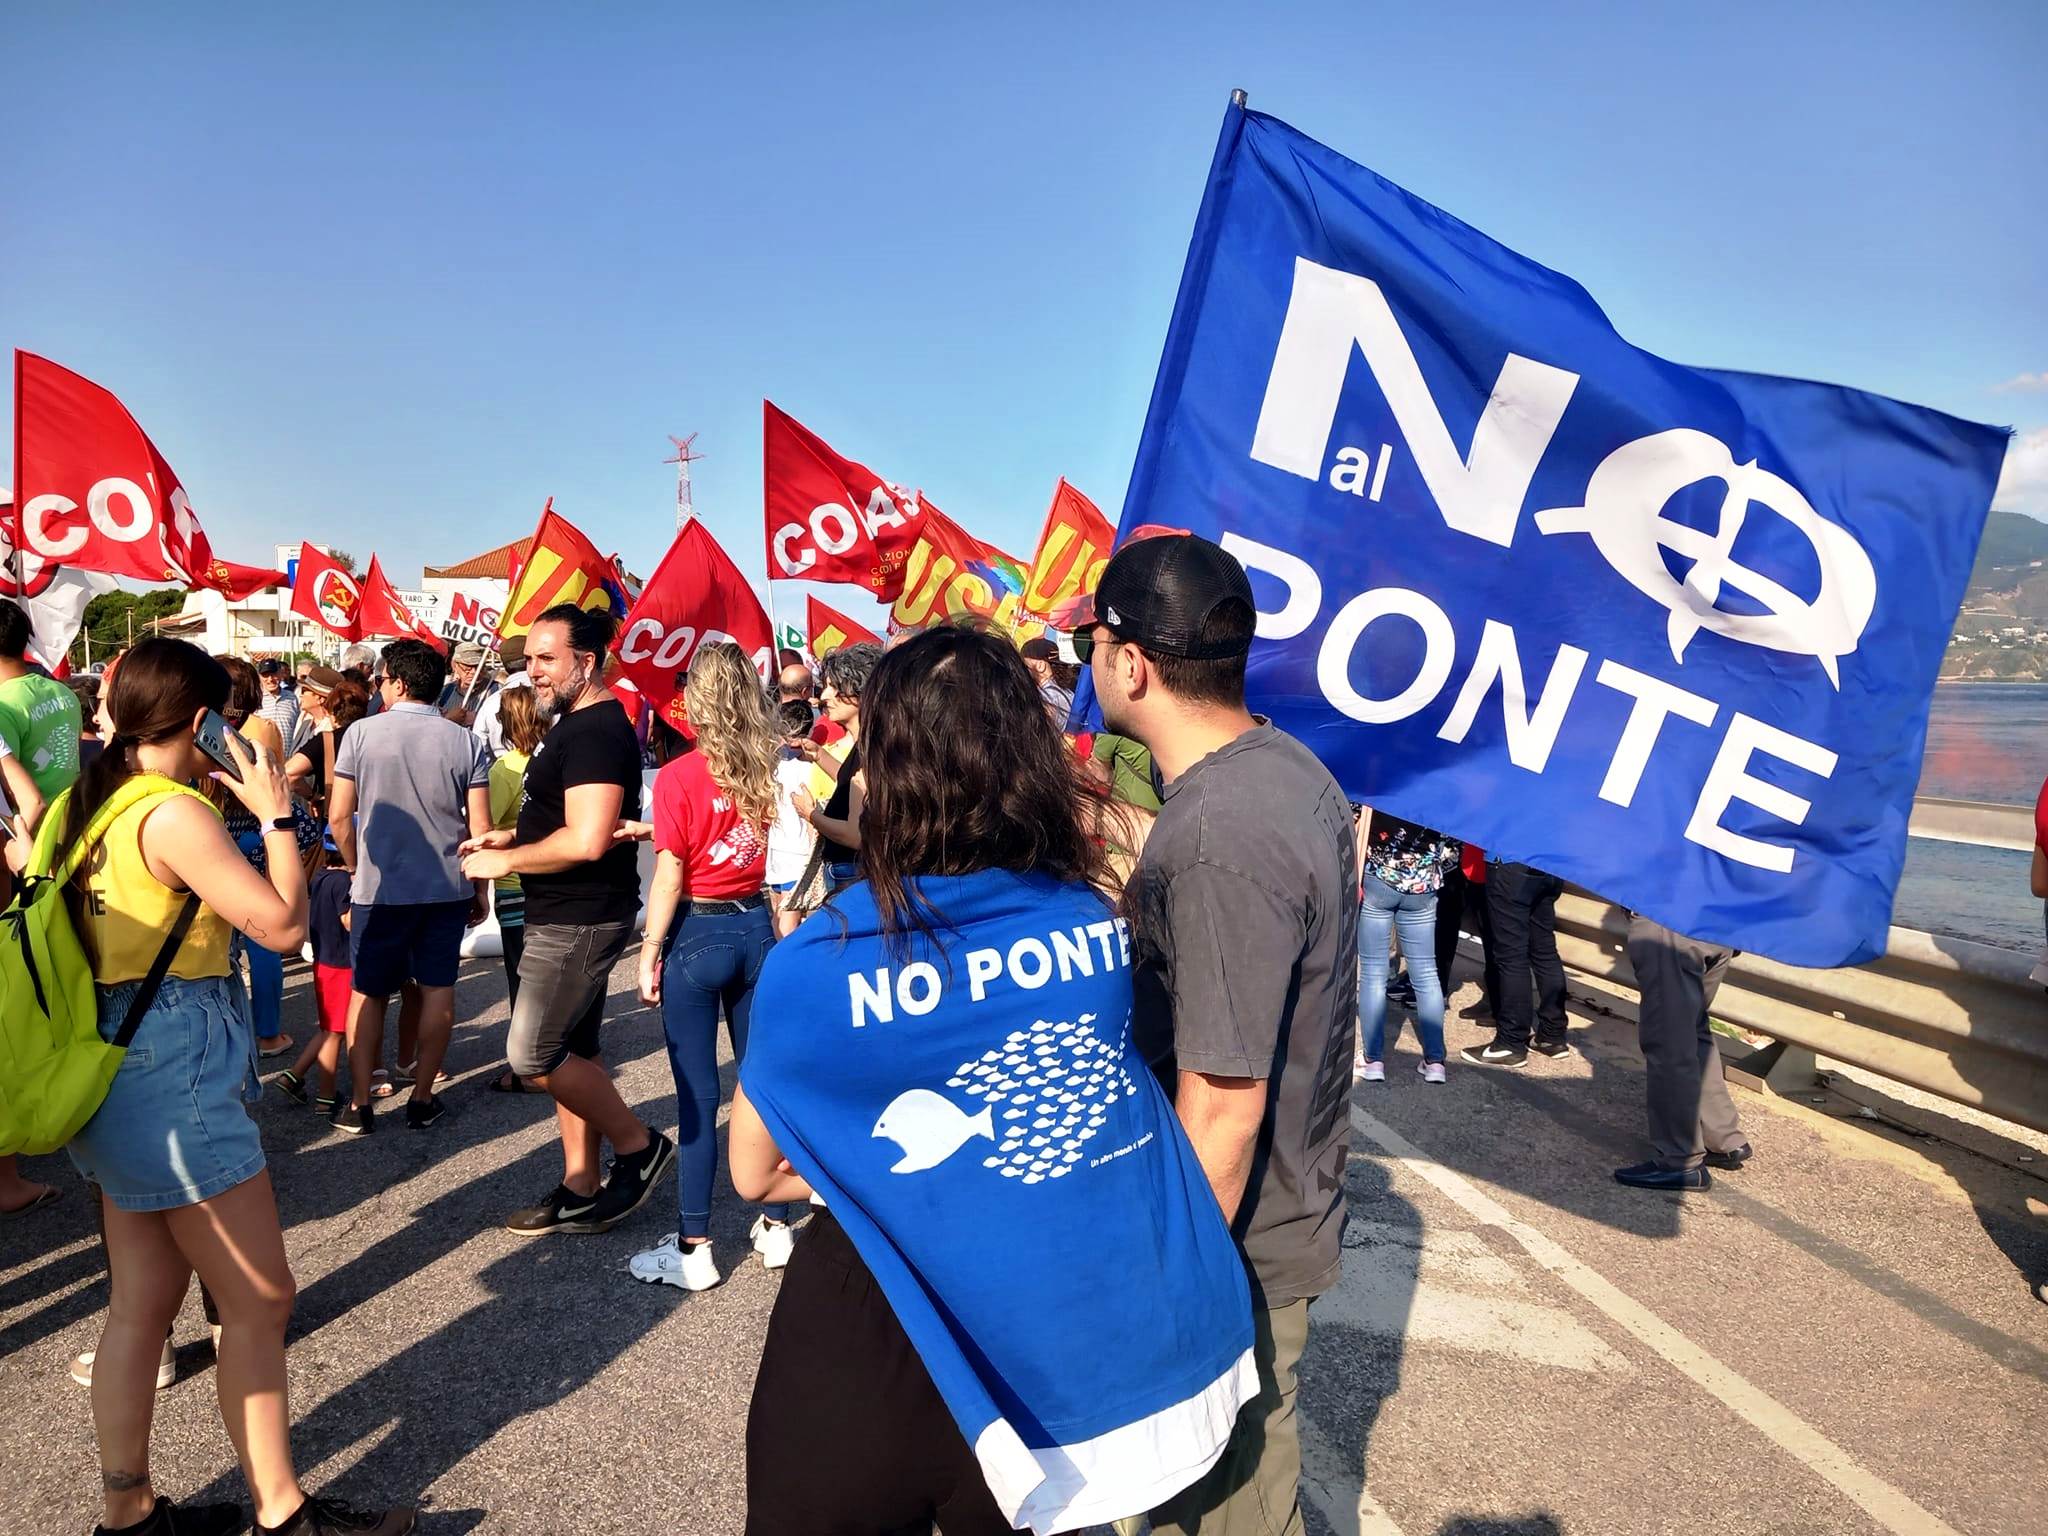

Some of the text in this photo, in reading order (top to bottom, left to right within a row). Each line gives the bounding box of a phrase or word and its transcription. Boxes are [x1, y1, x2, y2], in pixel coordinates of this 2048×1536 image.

[1328, 443, 1393, 504] al
[1219, 531, 1839, 875] PONTE
[847, 916, 1131, 1028] NO PONTE
